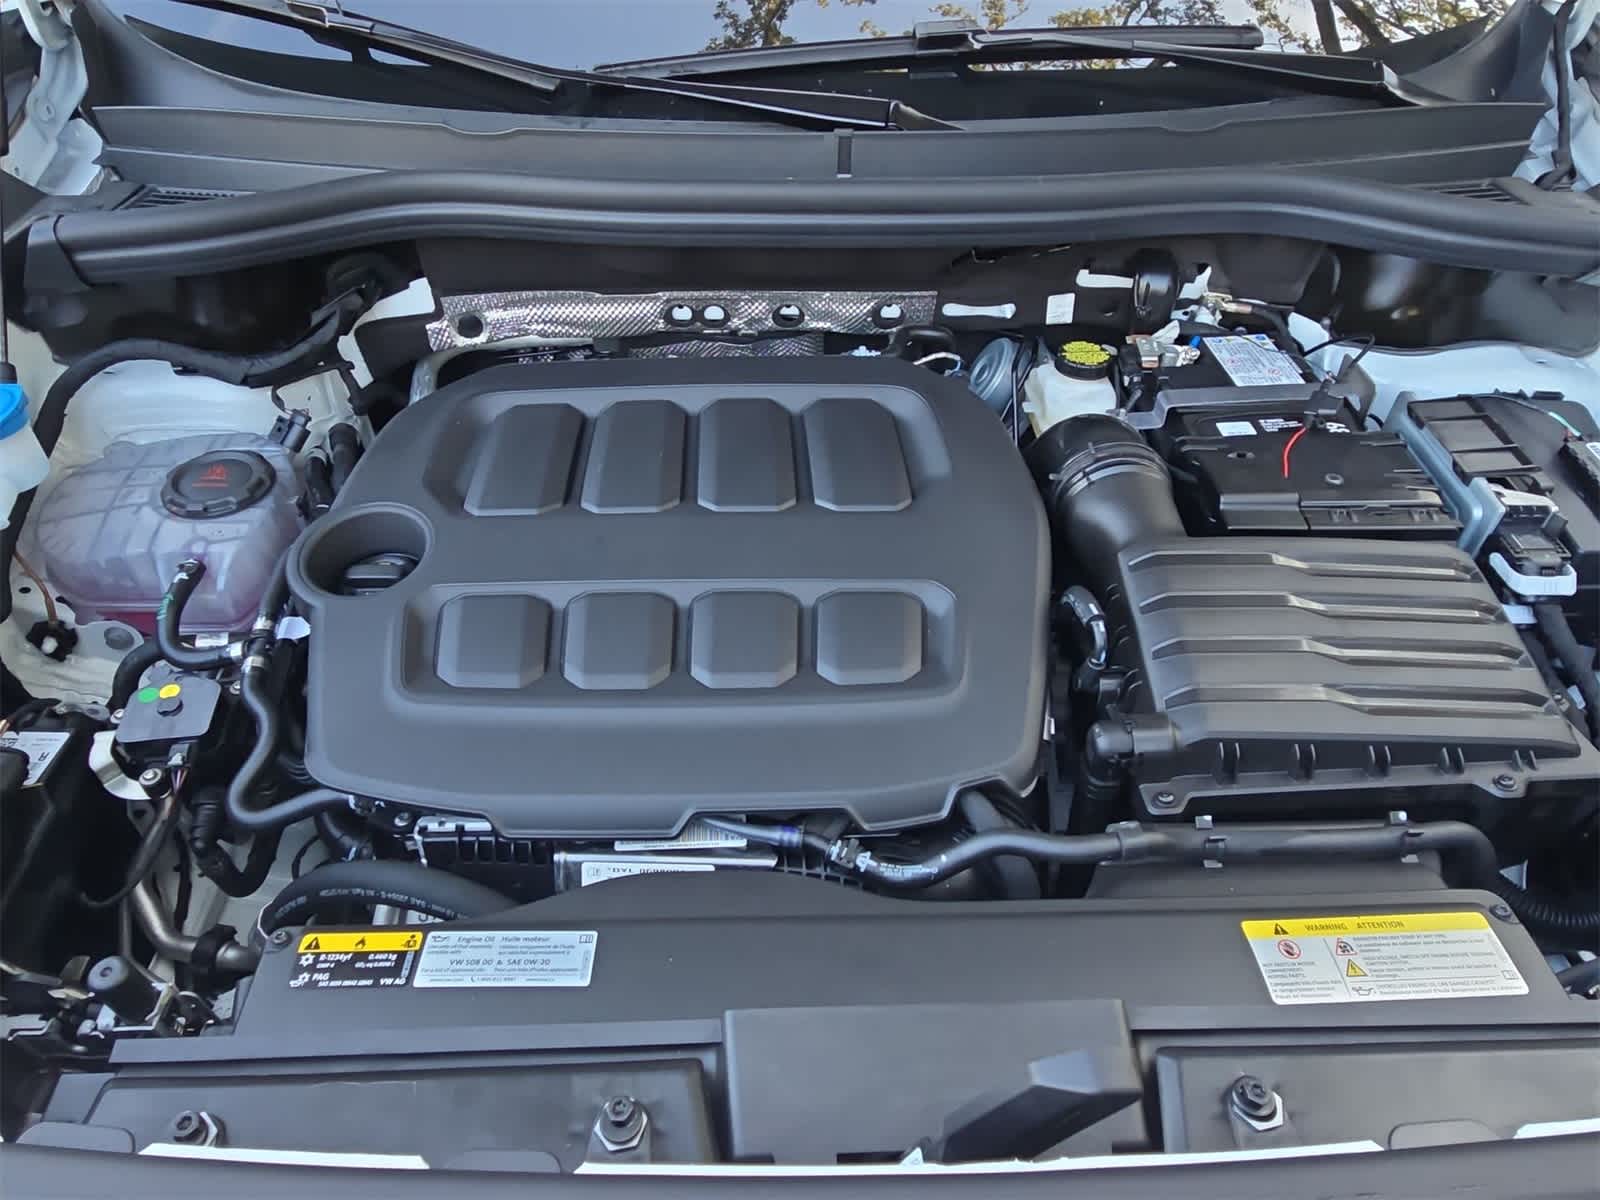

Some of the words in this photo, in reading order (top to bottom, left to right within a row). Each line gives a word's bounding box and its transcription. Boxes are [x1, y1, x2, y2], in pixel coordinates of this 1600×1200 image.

[1304, 922, 1348, 932] WARNING
[1357, 920, 1405, 930] ATTENTION
[457, 935, 483, 944] Engine
[502, 935, 521, 943] Huile
[311, 972, 331, 981] PAG
[380, 977, 394, 986] VW
